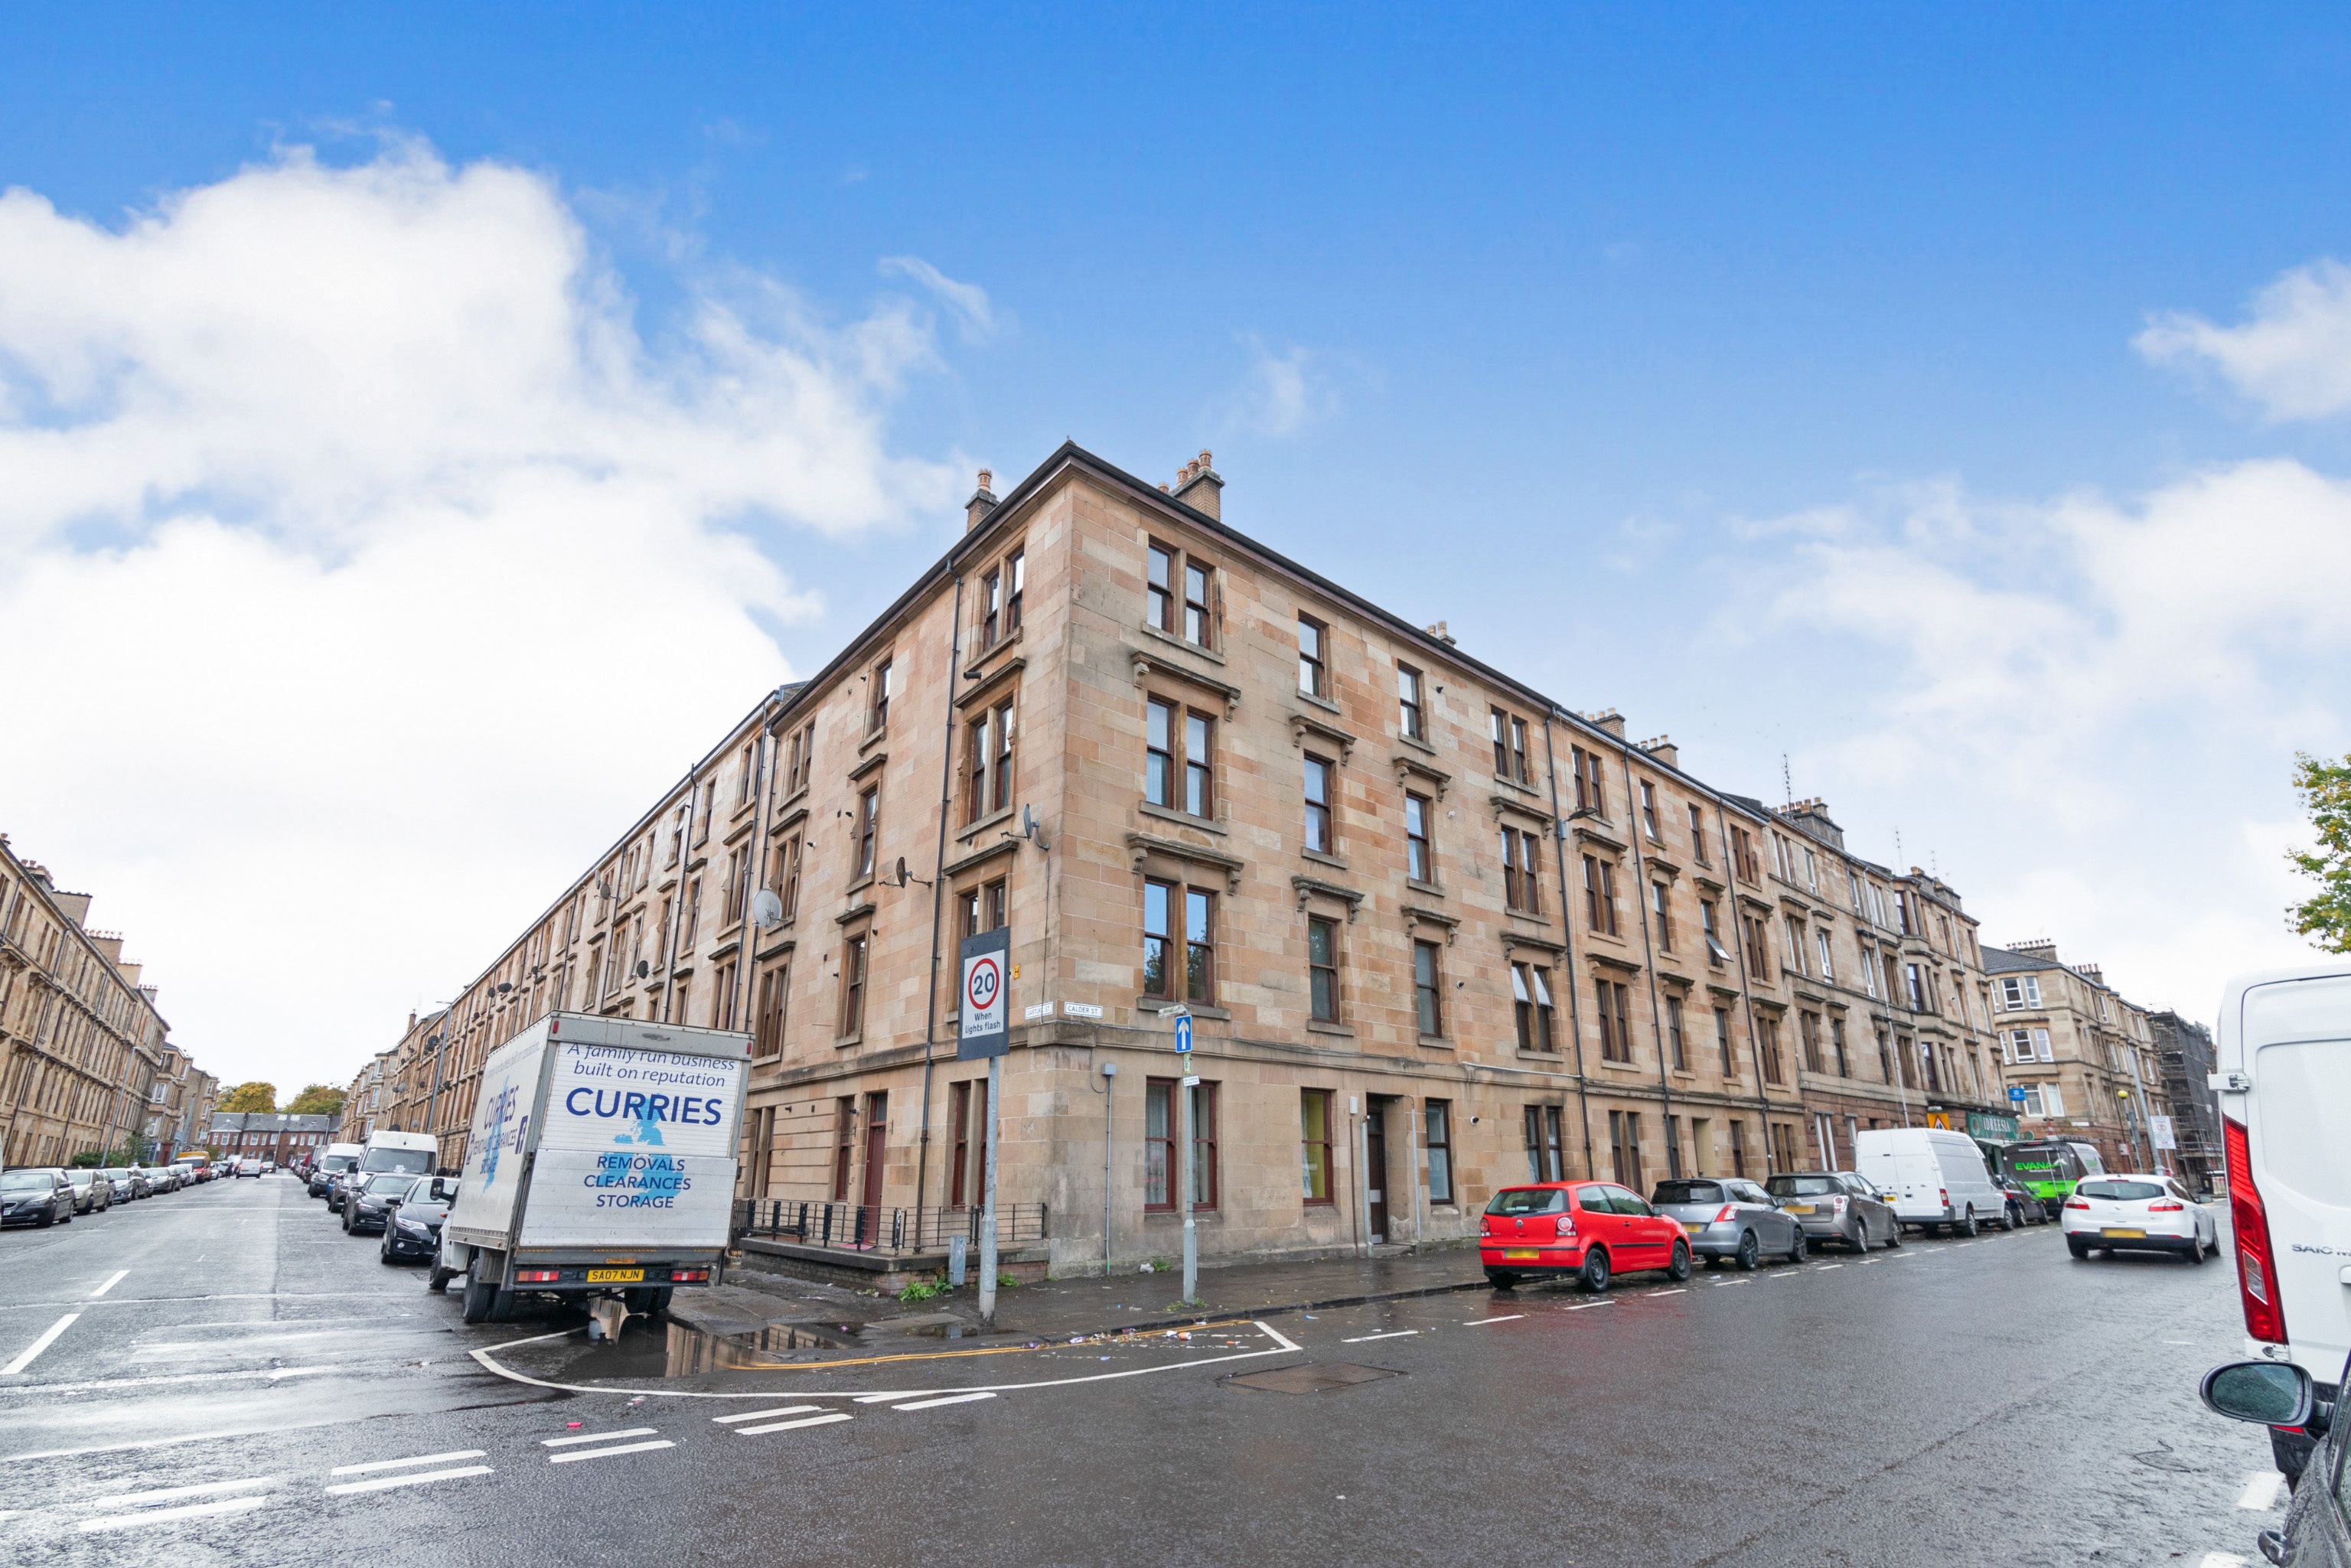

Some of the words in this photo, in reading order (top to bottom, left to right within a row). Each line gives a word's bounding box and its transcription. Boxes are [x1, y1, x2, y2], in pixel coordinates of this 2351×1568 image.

[973, 973, 995, 995] 20
[974, 1012, 992, 1021] When
[965, 1024, 983, 1035] lights
[985, 1020, 1001, 1030] flash
[567, 1042, 579, 1055] A
[585, 1045, 636, 1064] family
[640, 1051, 667, 1064] run
[671, 1053, 735, 1071] business
[574, 1061, 612, 1077] built
[617, 1068, 637, 1080] on
[642, 1069, 726, 1087] reputation
[484, 1084, 520, 1130] CURRIES
[566, 1087, 723, 1126] CURRIES
[597, 1156, 685, 1172] REMOVALS
[584, 1175, 691, 1190] CLEARANCES
[596, 1195, 674, 1208] STORAGE
[2291, 1244, 2333, 1254] SAIC
[592, 1270, 618, 1280] SA07
[620, 1270, 640, 1280] NJN
